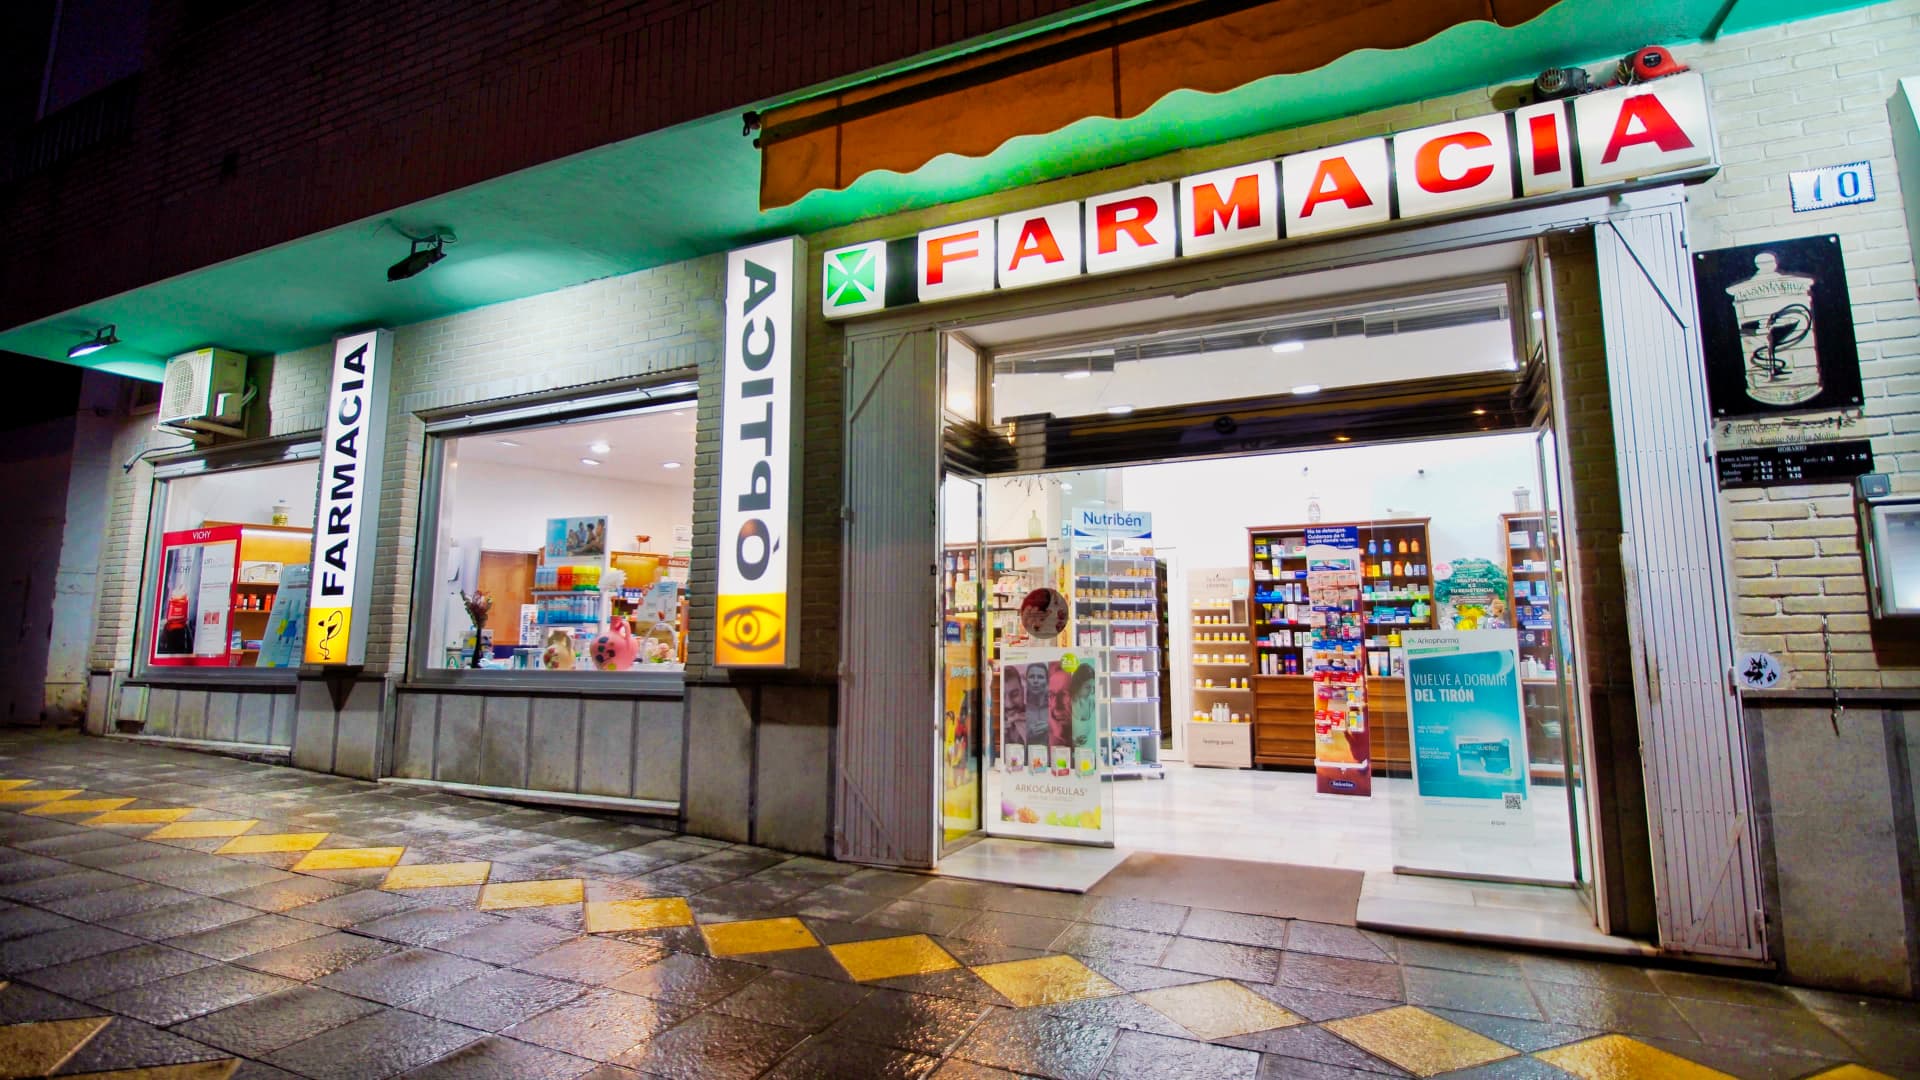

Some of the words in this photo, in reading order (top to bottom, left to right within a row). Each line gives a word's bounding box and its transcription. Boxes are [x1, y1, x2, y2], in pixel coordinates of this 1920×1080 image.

[925, 93, 1695, 286] FARMACIA
[321, 341, 369, 598] FARMACIA
[1083, 511, 1142, 527] Nutribén
[192, 530, 212, 540] VICHY
[1413, 673, 1453, 686] VUELVE
[1454, 674, 1461, 685] A
[1464, 673, 1508, 686] DORMIR
[1414, 689, 1437, 702] DEL
[1439, 686, 1475, 703] TIRÓN
